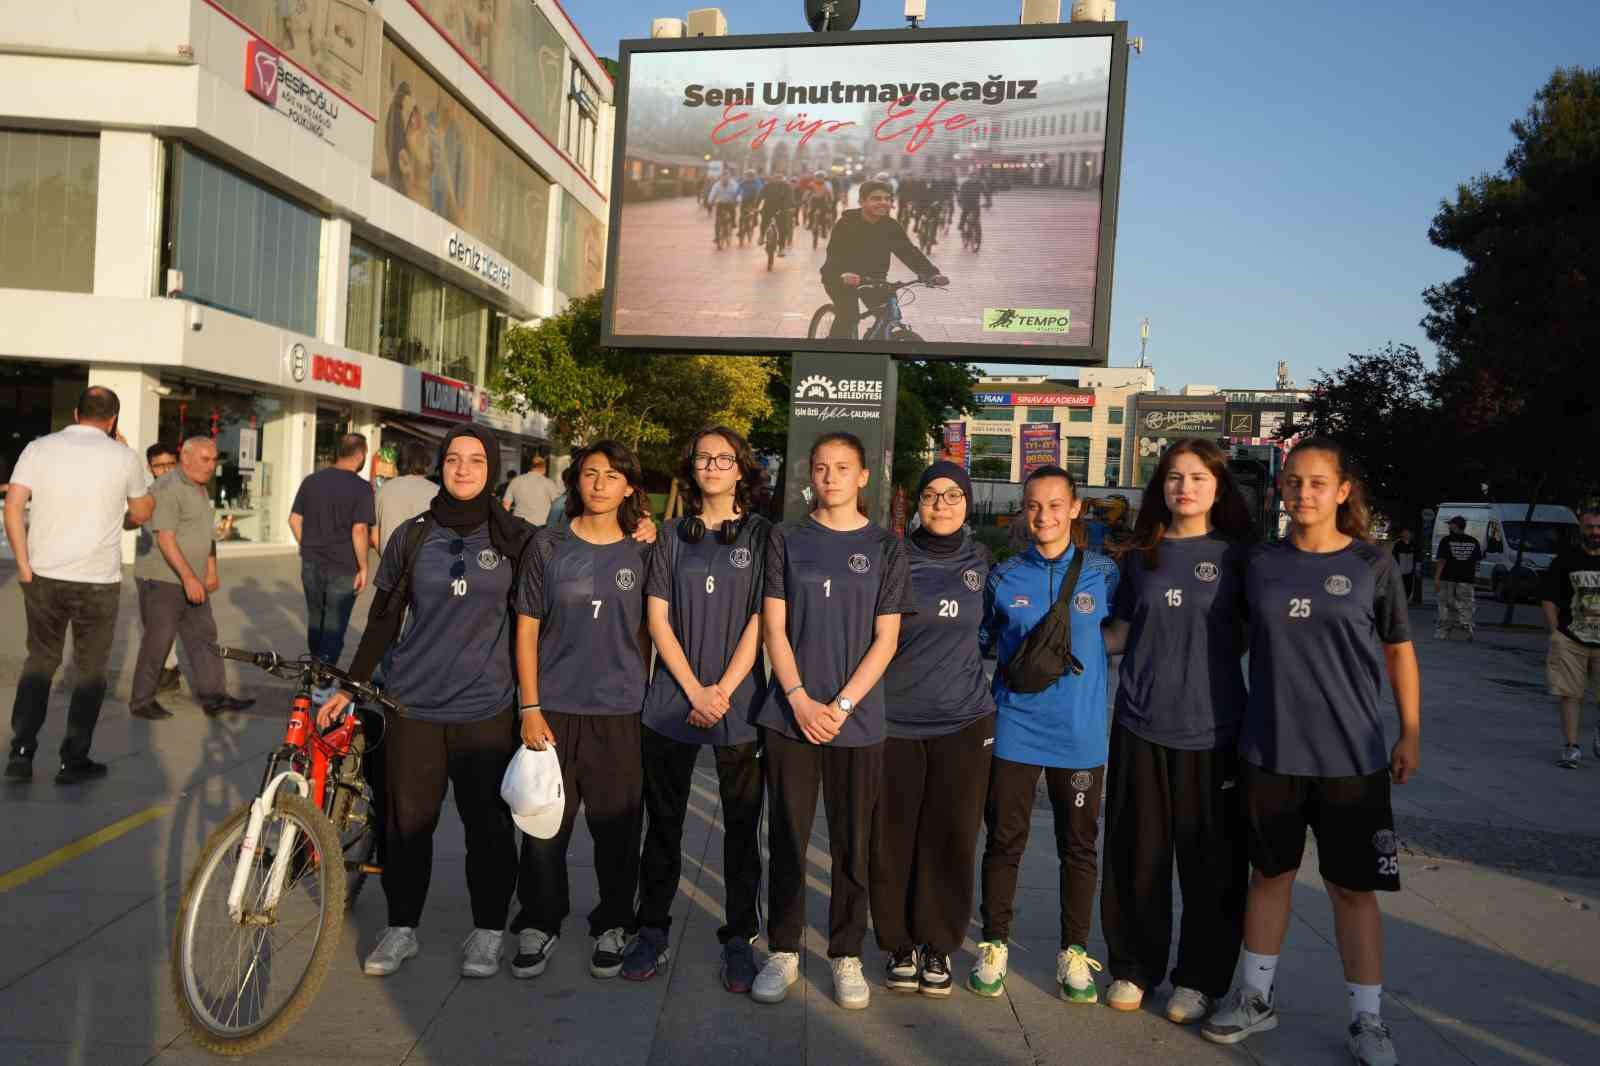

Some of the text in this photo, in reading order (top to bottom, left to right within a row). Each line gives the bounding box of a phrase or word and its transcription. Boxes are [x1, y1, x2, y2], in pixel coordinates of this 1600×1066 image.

[683, 75, 1038, 107] Seni Unutmayacağız
[710, 100, 856, 149] Eyüp
[449, 233, 512, 290] deniz ticaret
[1019, 316, 1069, 327] TEMPO
[312, 353, 362, 389] BOSCH
[837, 391, 883, 400] BELEDİYESİ
[838, 380, 883, 393] GEBZE
[1017, 395, 1043, 405] SINAV
[1043, 394, 1090, 405] AKADEMİSİ
[451, 579, 467, 596] 10
[705, 575, 715, 594] 6
[823, 579, 832, 597] 1
[1165, 588, 1183, 607] 15
[591, 600, 602, 619] 7
[938, 599, 959, 618] 20
[1288, 598, 1312, 618] 25
[1074, 792, 1085, 808] 8
[1378, 857, 1399, 875] 25
